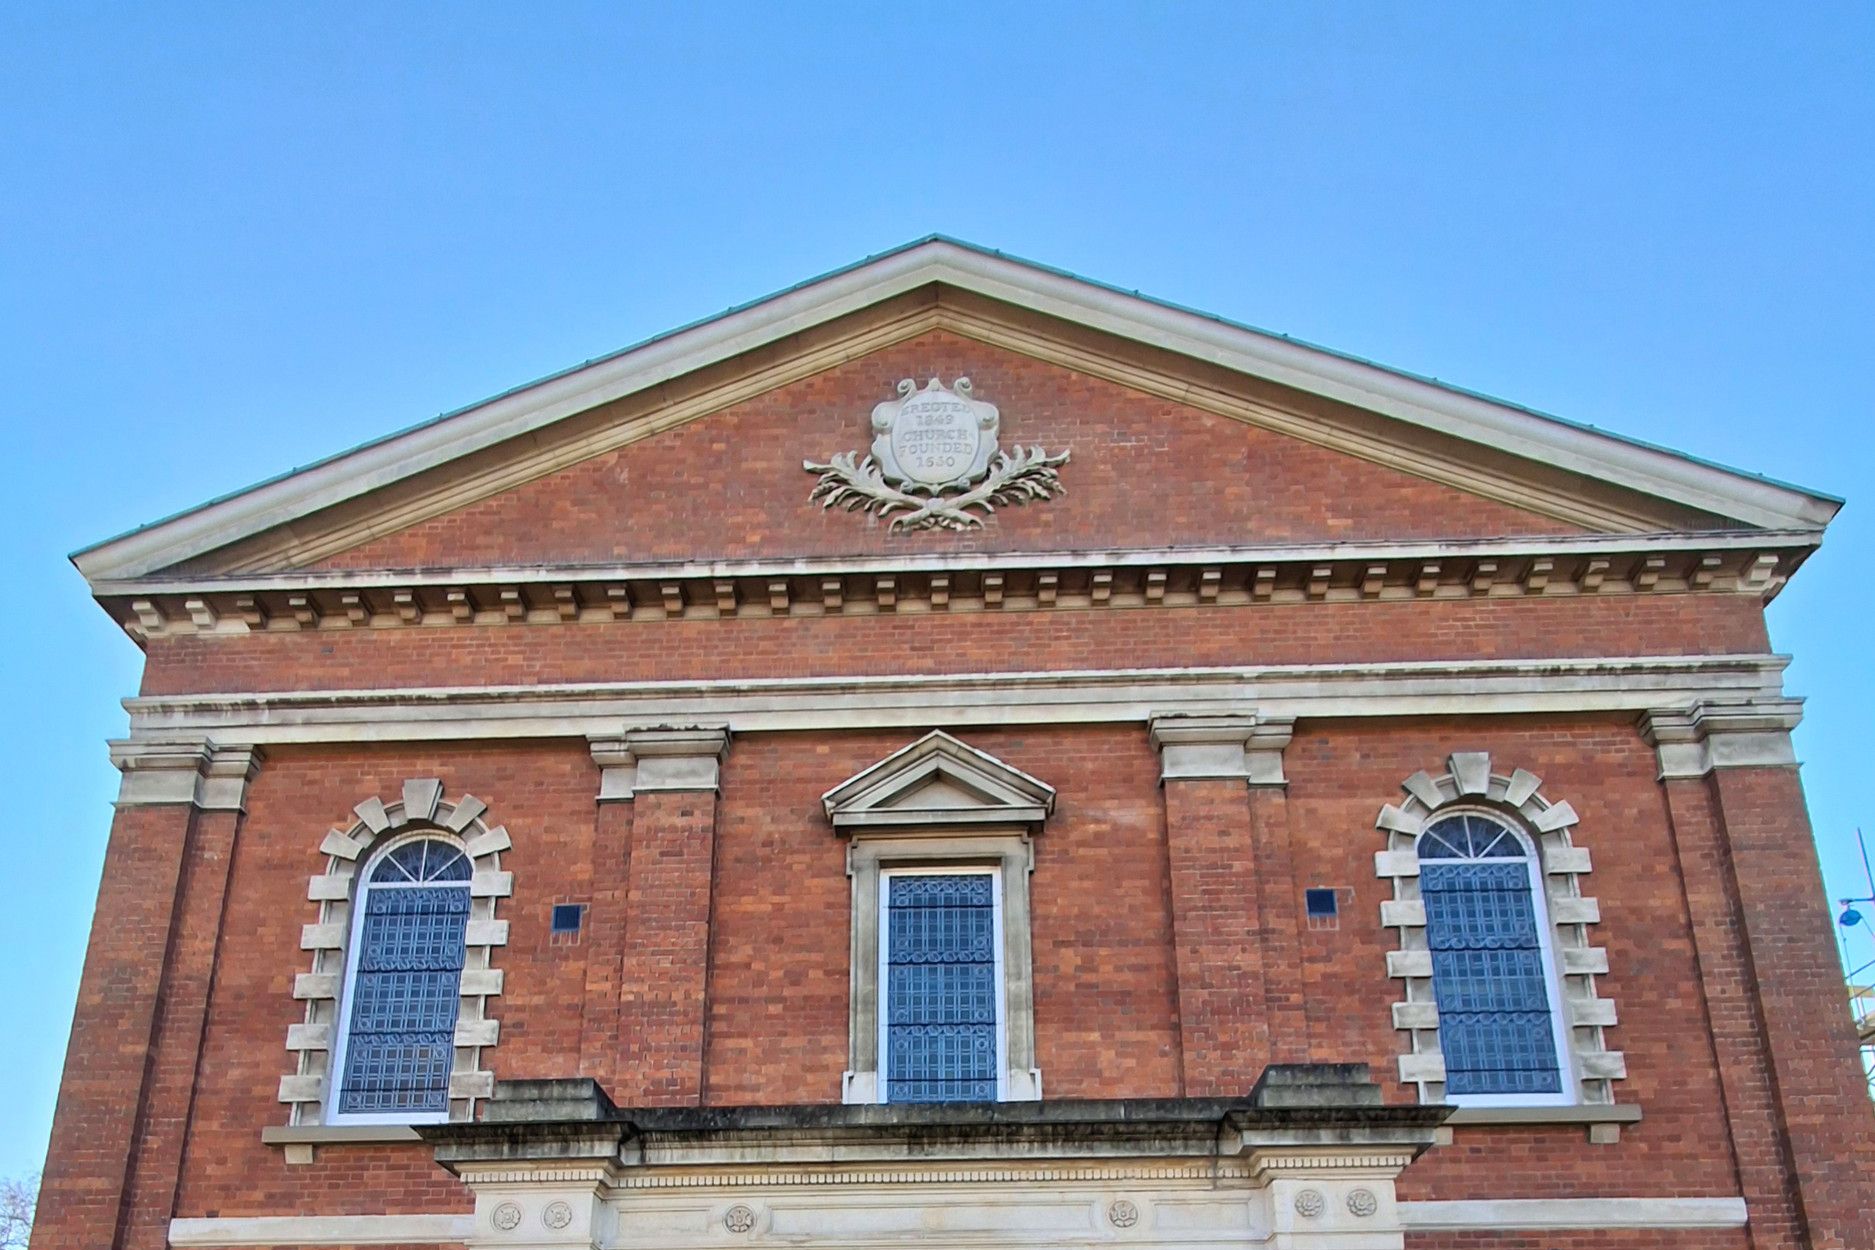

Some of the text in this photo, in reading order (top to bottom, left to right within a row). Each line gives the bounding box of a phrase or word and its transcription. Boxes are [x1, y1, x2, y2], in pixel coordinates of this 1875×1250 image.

[901, 402, 971, 416] ERECTED
[916, 415, 954, 426] 1849
[903, 429, 968, 441] CHURCH
[899, 442, 973, 458] FOUNDED
